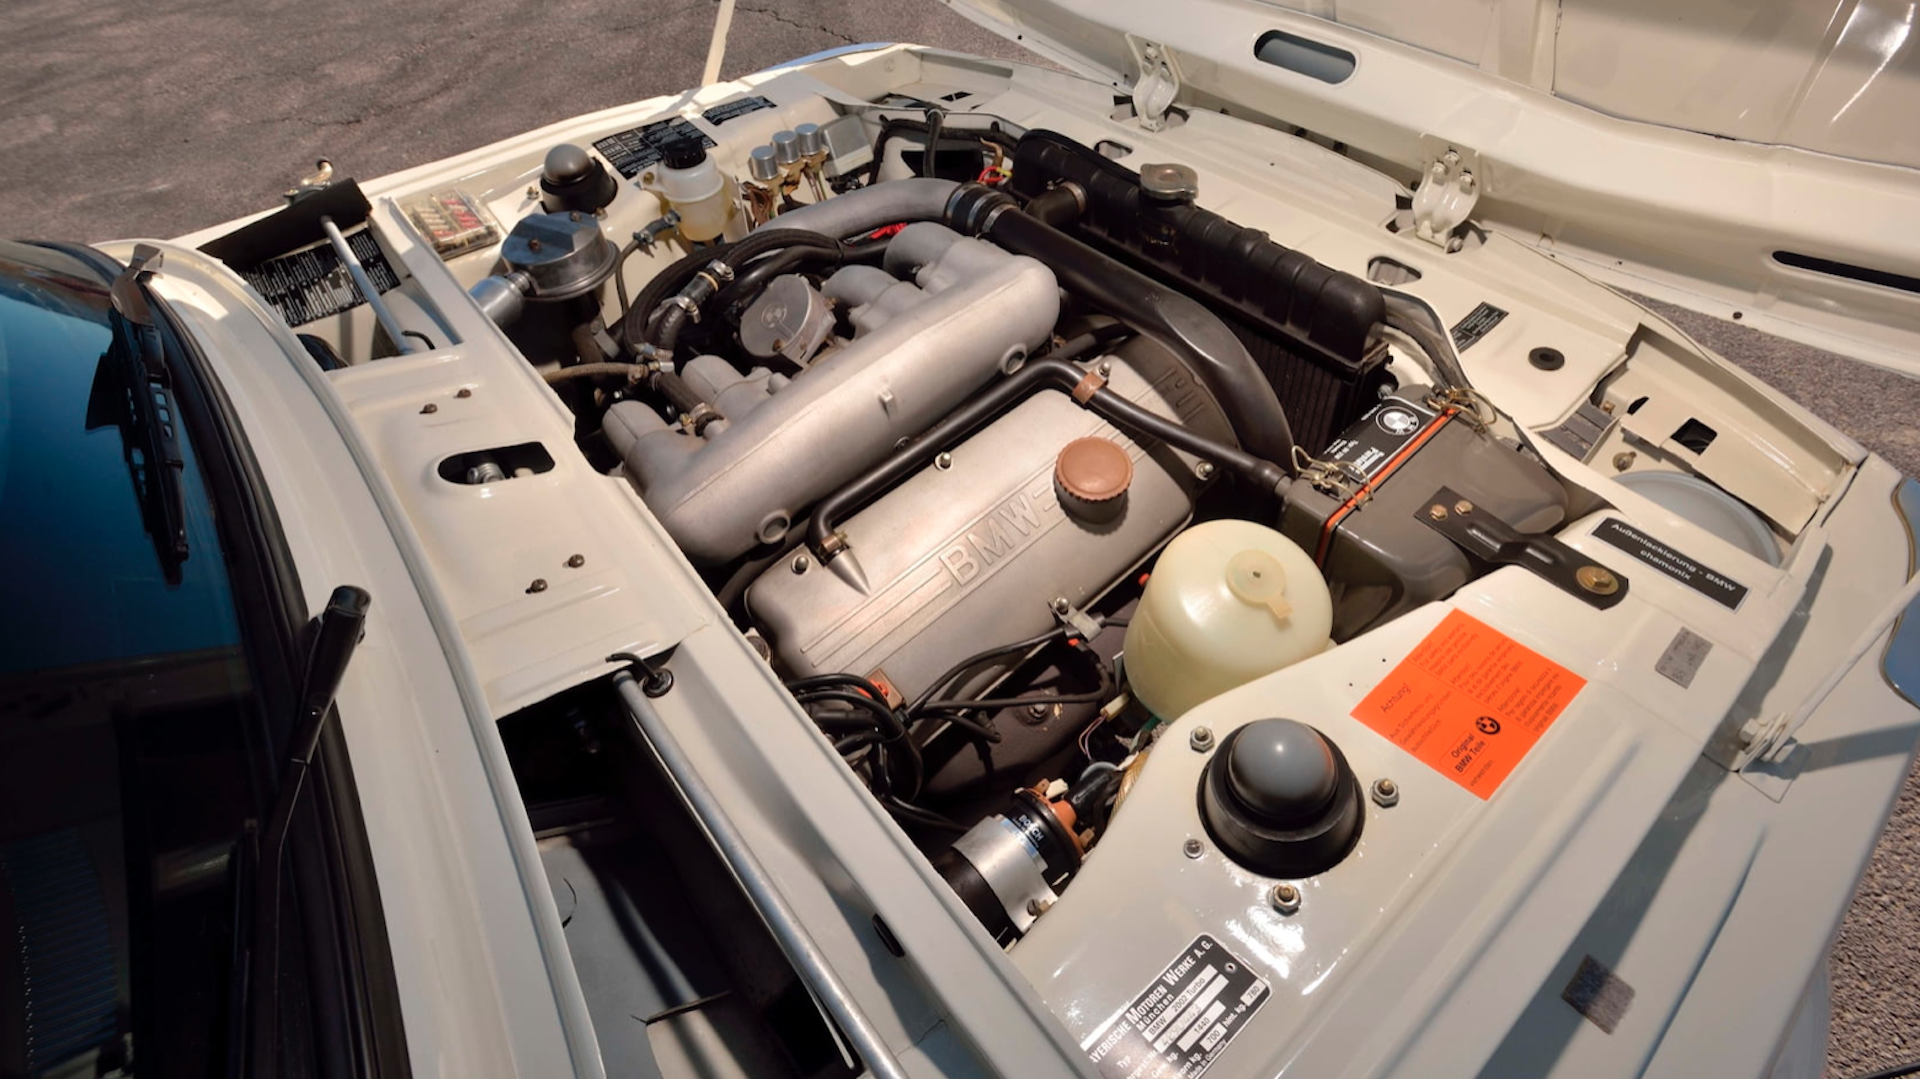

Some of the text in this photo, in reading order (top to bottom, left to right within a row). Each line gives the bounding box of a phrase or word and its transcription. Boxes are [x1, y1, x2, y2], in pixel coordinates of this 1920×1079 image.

[939, 494, 1041, 587] BMW
[1611, 523, 1697, 573] Außenlackierung
[1705, 573, 1736, 591] BMW
[1451, 733, 1475, 758] Original
[1455, 740, 1486, 773] BMW Teile
[1018, 814, 1044, 842] BOSCH
[1089, 1021, 1132, 1064] AYERISCHE
[1125, 984, 1168, 1025] MOTOREN
[1162, 955, 1197, 986] WERKE
[1135, 993, 1175, 1032] München
[1148, 977, 1206, 1036] BMW 2002 Turbo
[1188, 1052, 1202, 1064] kg.
[1207, 1030, 1221, 1044] 700
[1246, 985, 1260, 1000] 780
[1165, 1051, 1179, 1063] kg.
[1193, 1017, 1211, 1034] 1440
